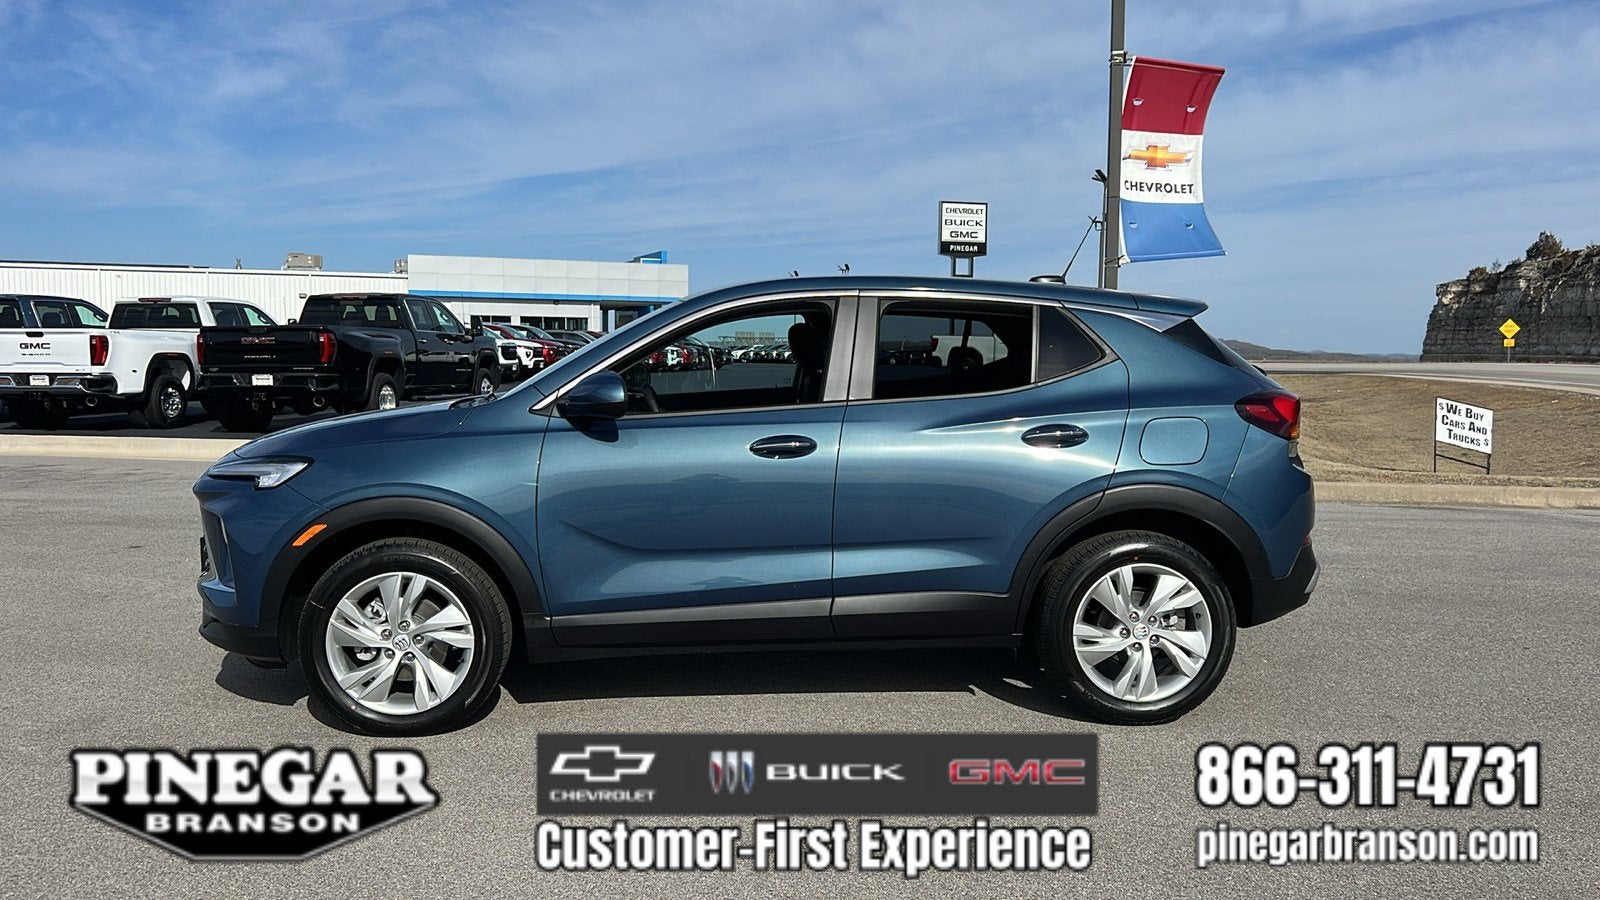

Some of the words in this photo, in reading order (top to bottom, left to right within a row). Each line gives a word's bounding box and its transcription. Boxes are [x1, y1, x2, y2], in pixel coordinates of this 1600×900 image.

[1124, 180, 1194, 194] CHEVROLET
[945, 207, 984, 215] CHEVROLET
[944, 219, 983, 227] BUICK
[950, 230, 978, 239] GMC
[949, 244, 978, 252] PINEGAR
[19, 342, 51, 350] GMC
